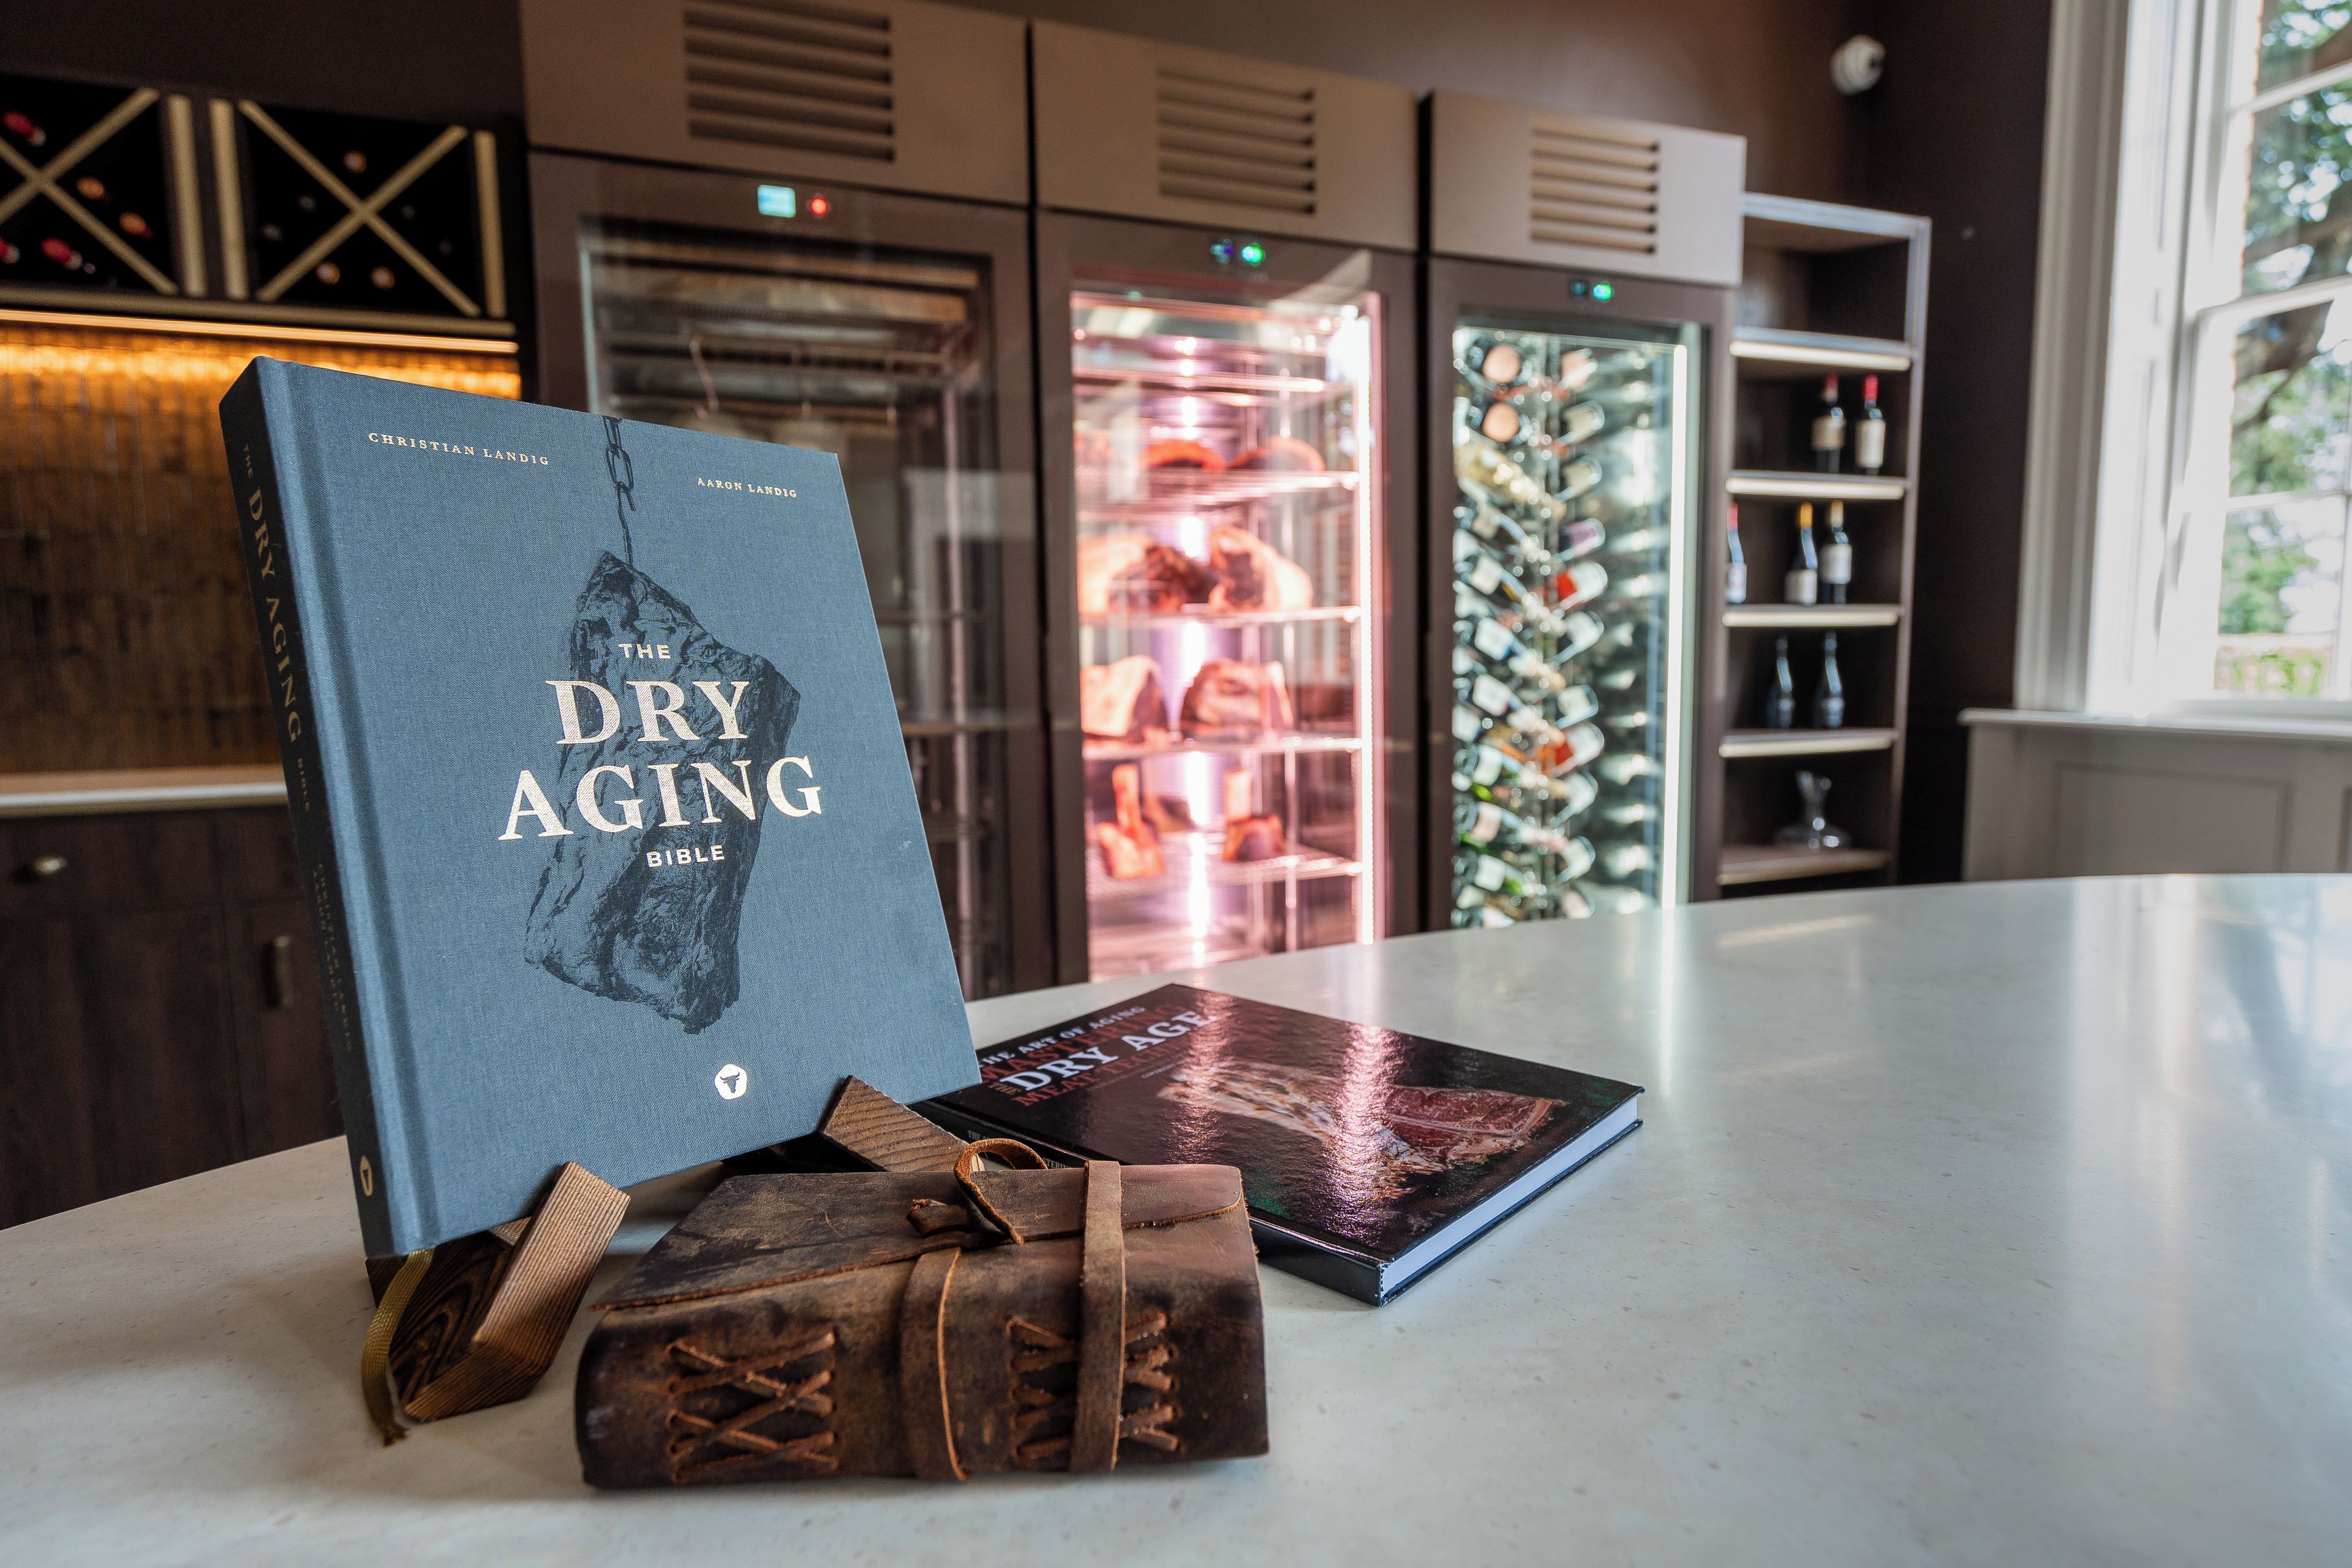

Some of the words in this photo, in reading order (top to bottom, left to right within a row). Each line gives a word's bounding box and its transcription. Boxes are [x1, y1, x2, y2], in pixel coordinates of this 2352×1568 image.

[368, 432, 474, 456] CHRISTIAN
[483, 448, 549, 466] LANDIG
[697, 477, 742, 491] AARON
[747, 483, 797, 497] LANDIG
[249, 486, 276, 581] DRY
[266, 597, 301, 743] AGING
[618, 643, 671, 659] THE
[545, 679, 750, 745] DRY
[498, 755, 822, 840] AGING
[646, 845, 725, 868] BIBLE
[978, 1050, 1016, 1068] HE
[1017, 1036, 1058, 1054] ART
[1059, 1026, 1086, 1039] OF
[1088, 1005, 1146, 1030] AGING
[998, 1046, 1119, 1091] DRY
[1121, 1011, 1218, 1052] AGE
[1012, 1072, 1097, 1106] MEAT
